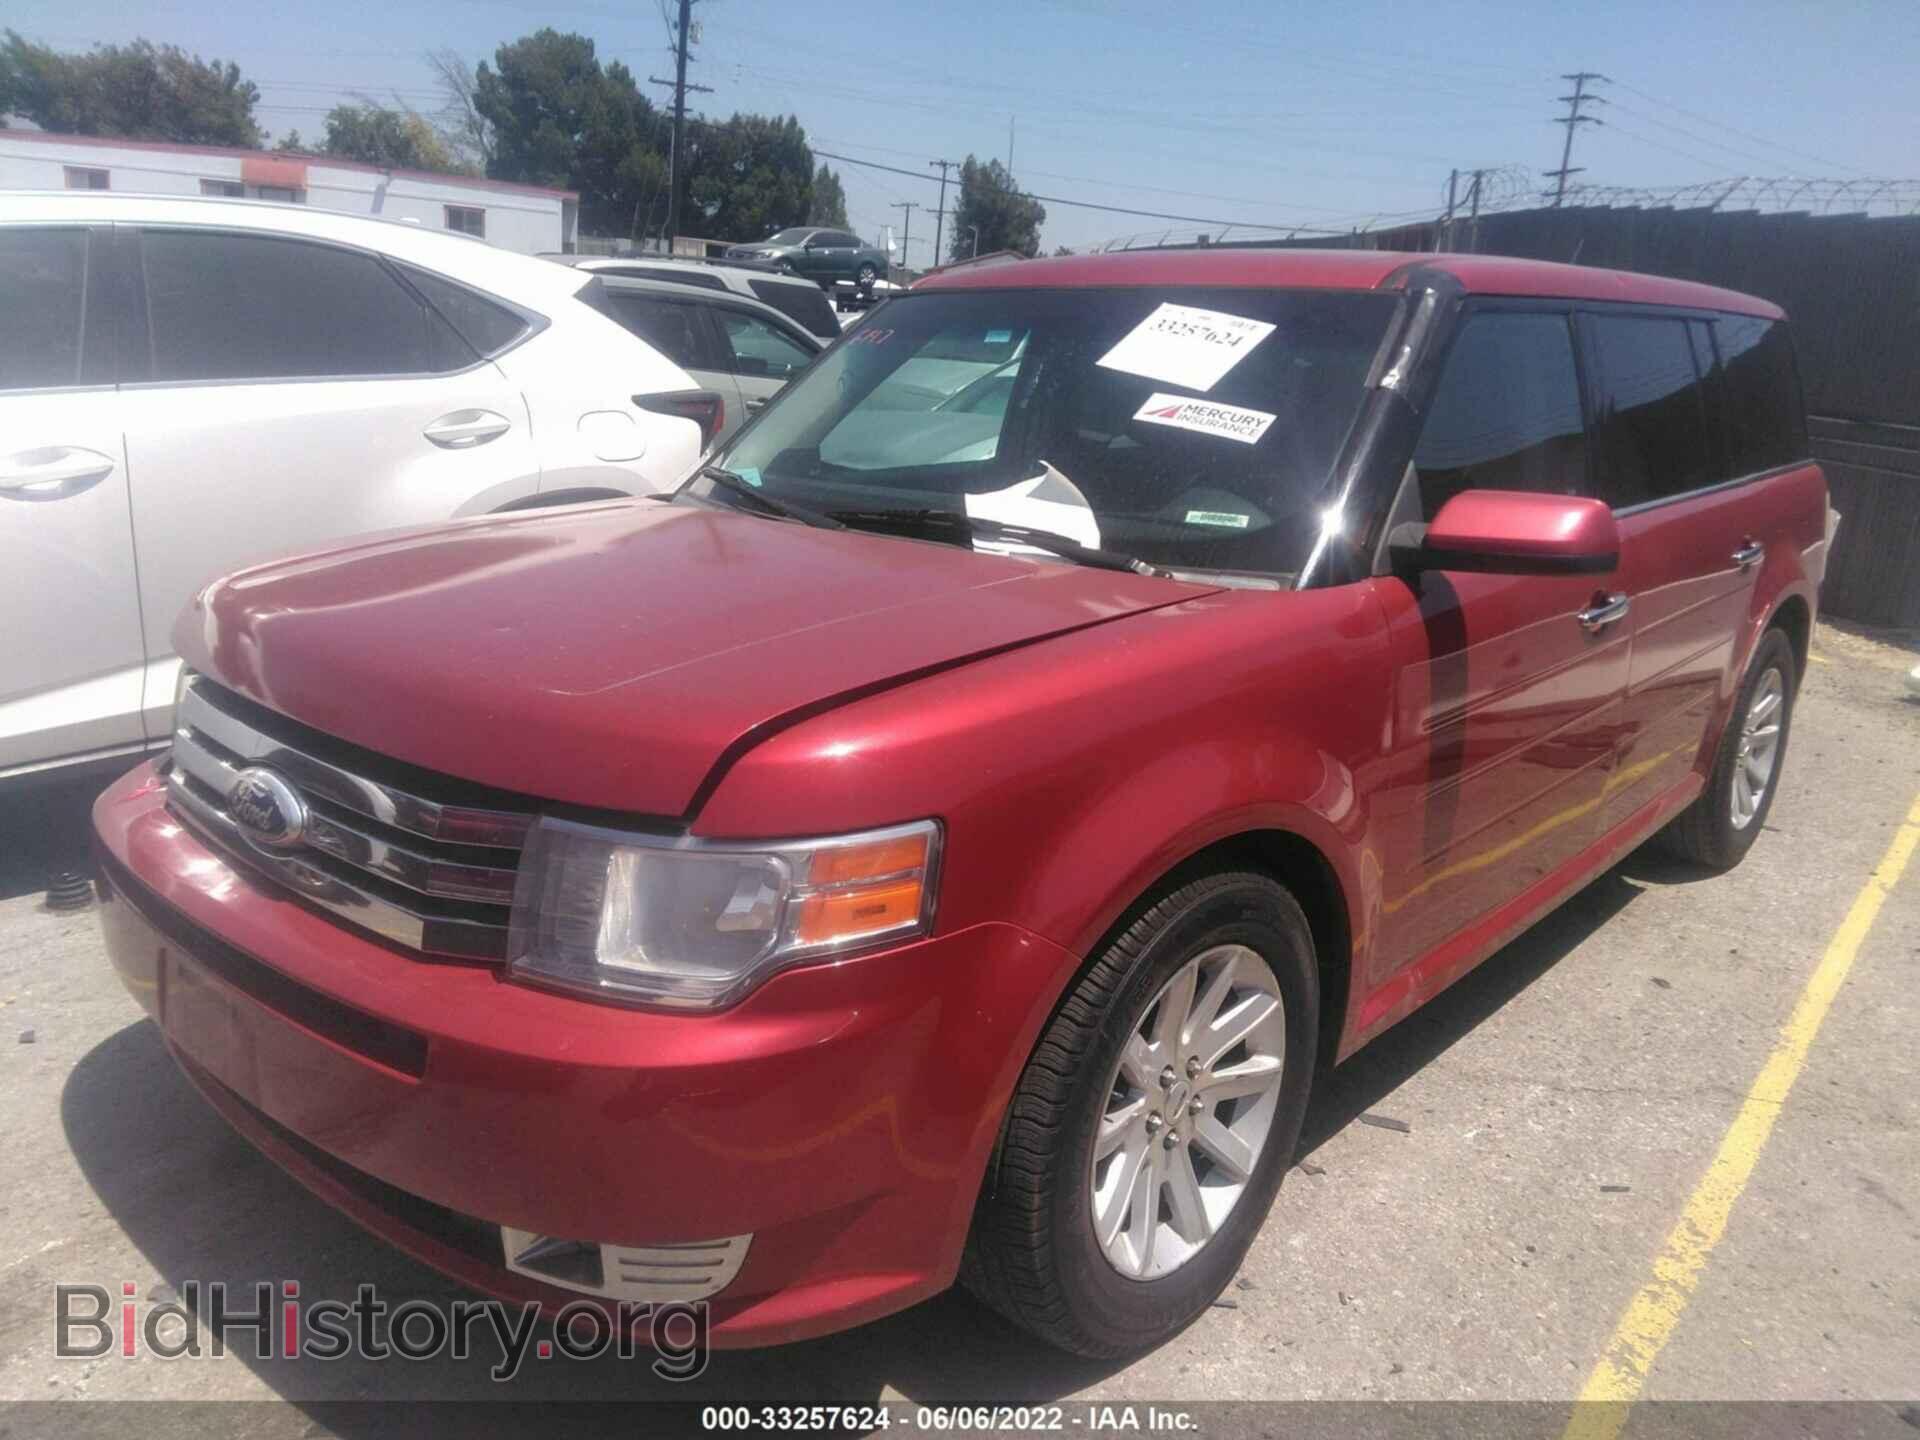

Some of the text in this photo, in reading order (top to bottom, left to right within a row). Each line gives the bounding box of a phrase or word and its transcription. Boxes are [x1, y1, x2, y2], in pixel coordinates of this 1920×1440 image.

[1149, 319, 1244, 347] 33257624
[1177, 413, 1261, 437] INSURANCE
[1183, 404, 1268, 428] MERCURY
